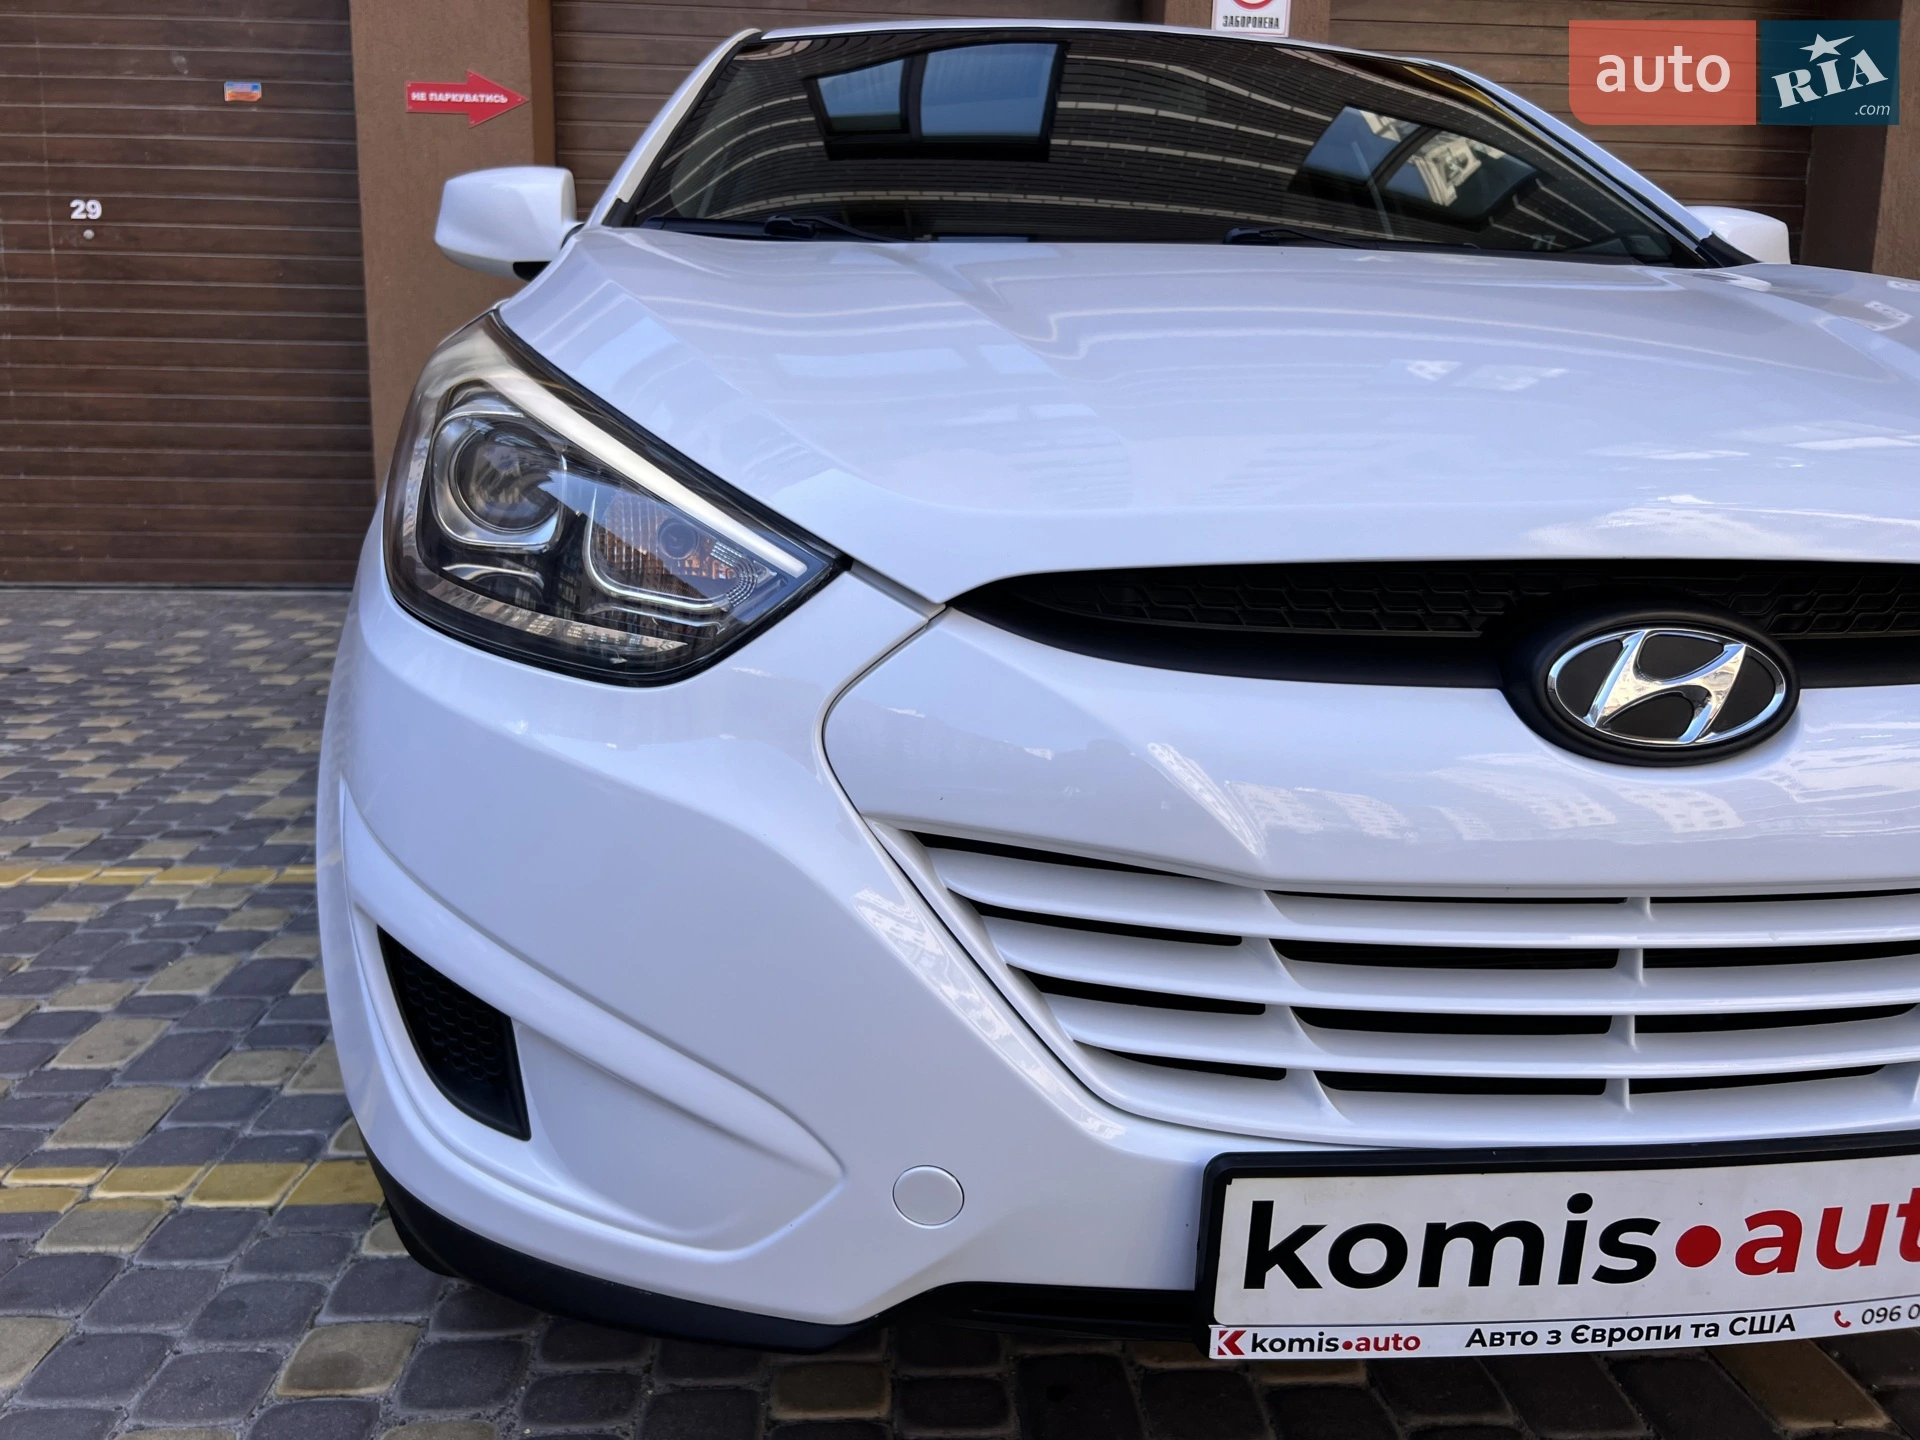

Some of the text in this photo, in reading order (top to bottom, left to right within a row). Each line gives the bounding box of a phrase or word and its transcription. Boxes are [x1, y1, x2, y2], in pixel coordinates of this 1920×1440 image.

[1222, 15, 1280, 30] ЗАБОРОНЕНА
[410, 91, 508, 104] НЕ ПАРКУВАТИСЬ
[70, 199, 103, 220] 29
[1861, 1305, 1902, 1325] 096
[1464, 1313, 1797, 1348] Авто з Європи та США
